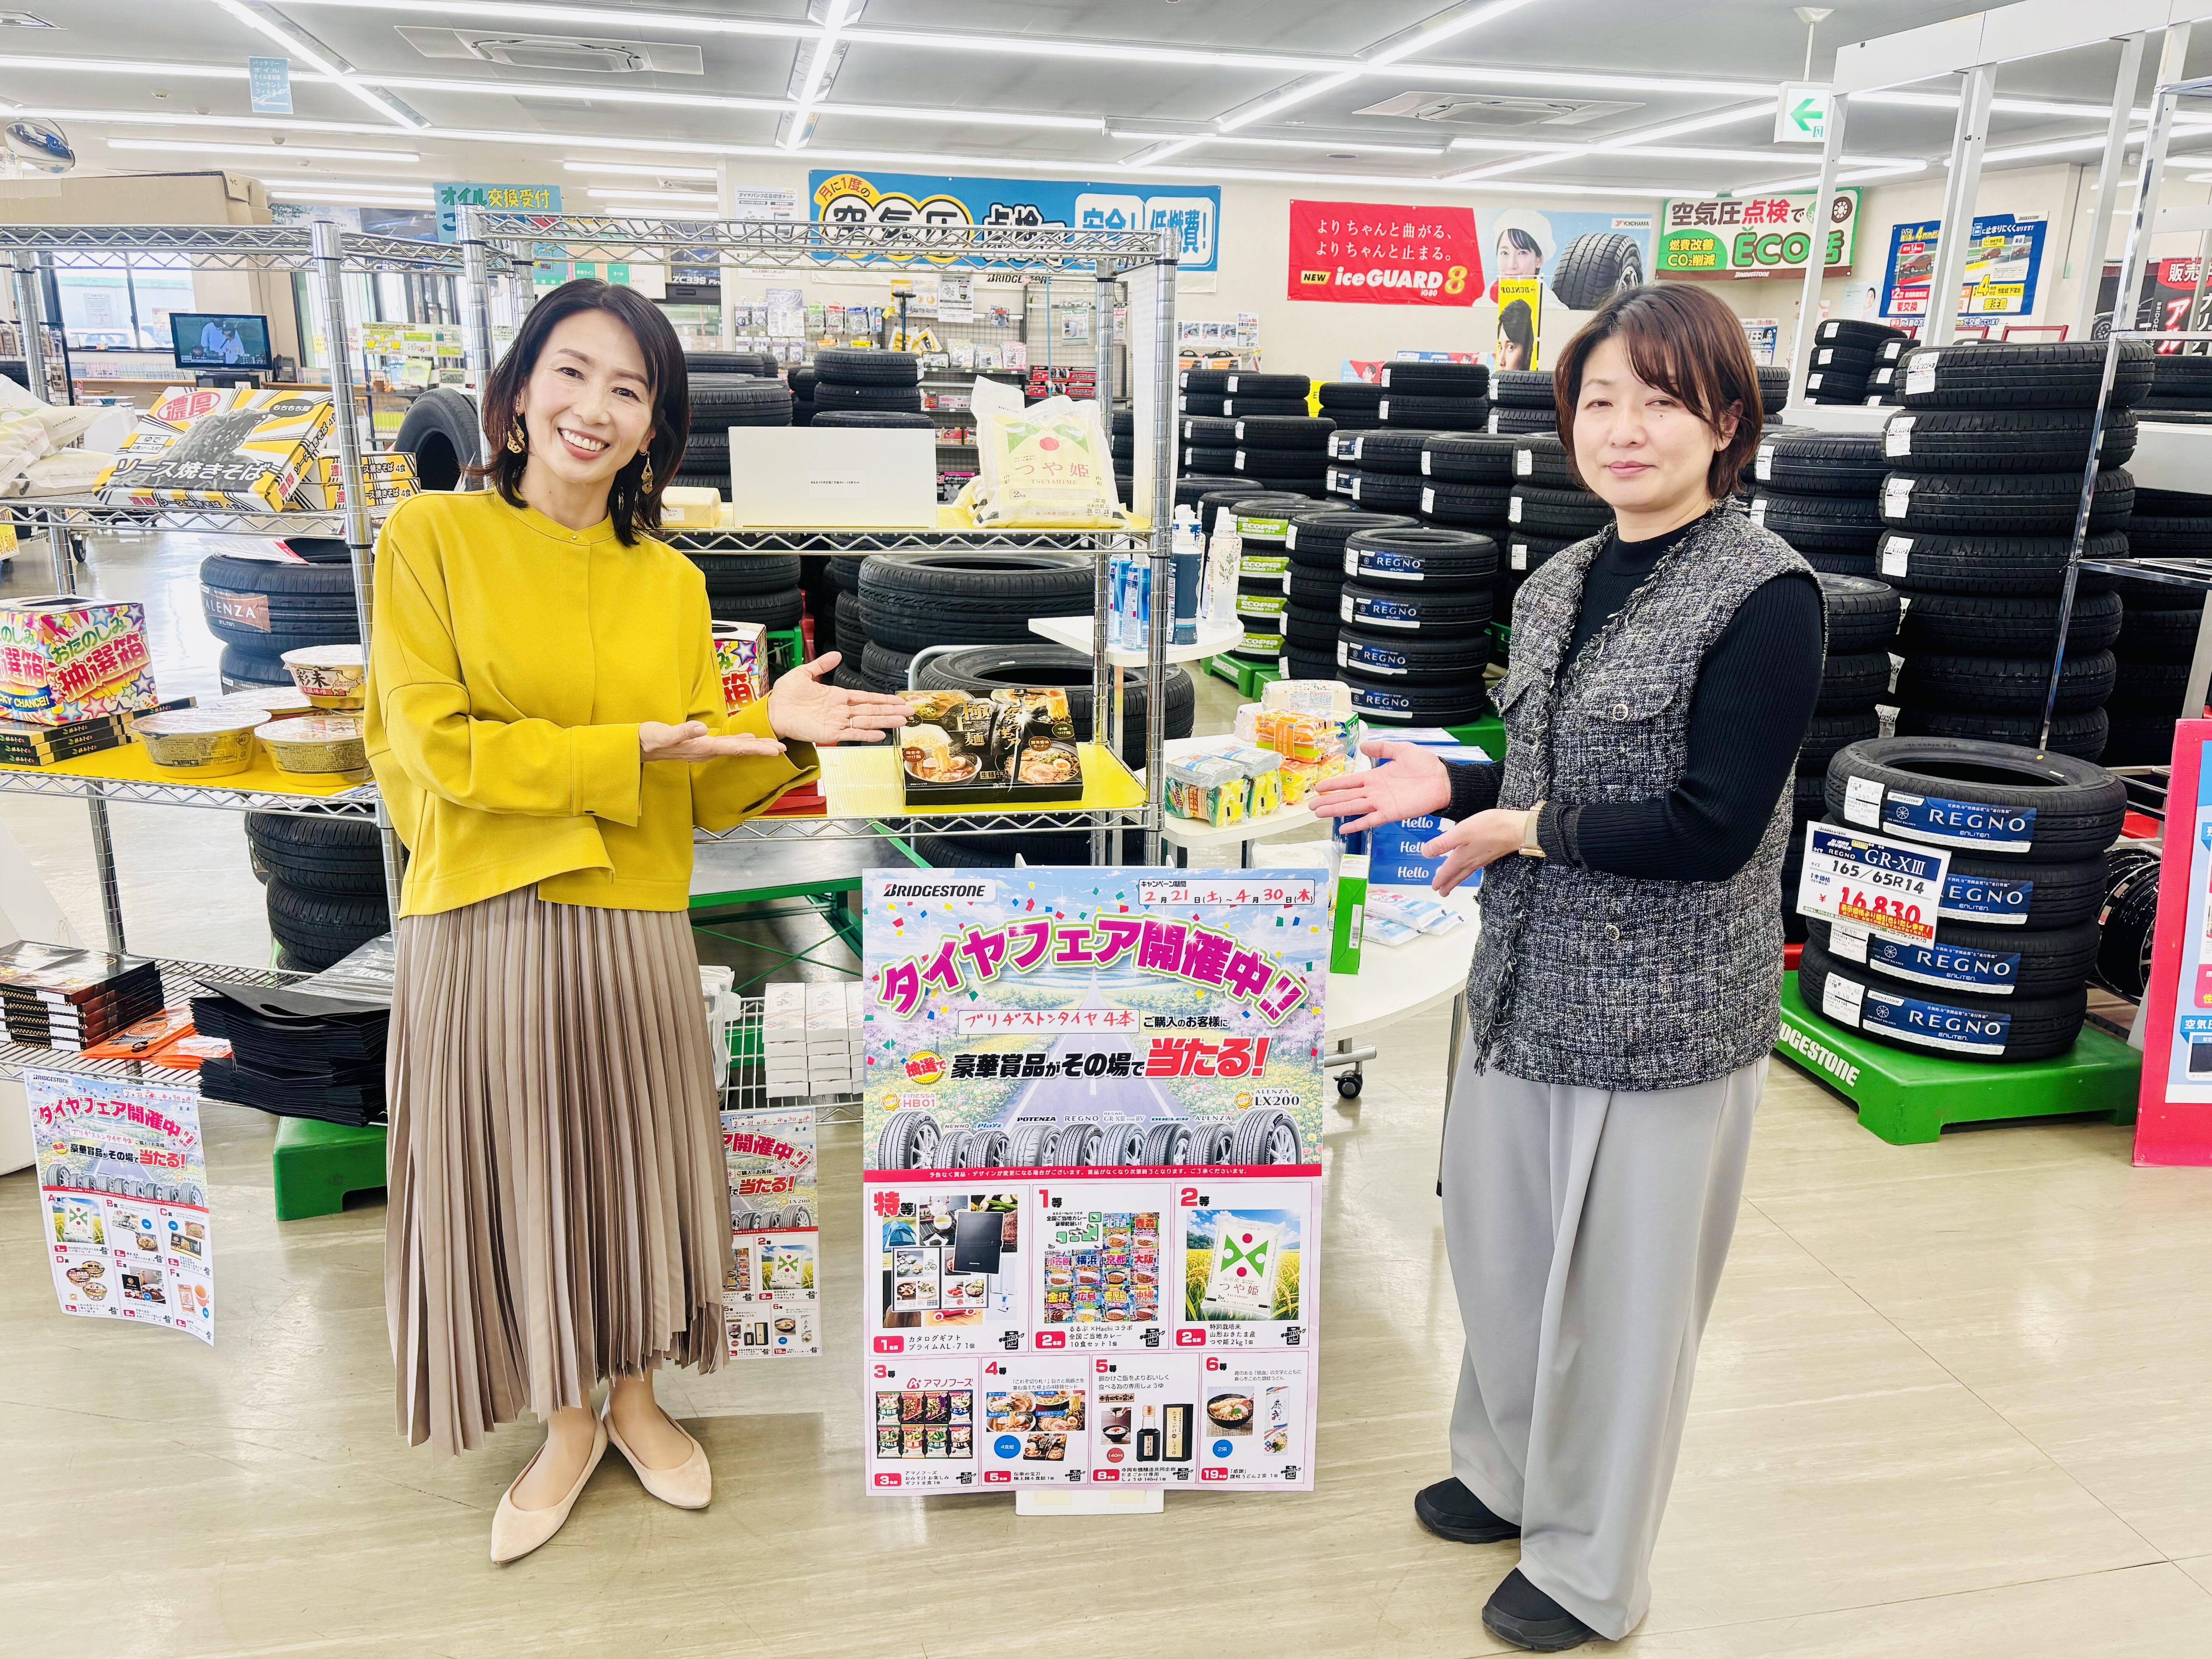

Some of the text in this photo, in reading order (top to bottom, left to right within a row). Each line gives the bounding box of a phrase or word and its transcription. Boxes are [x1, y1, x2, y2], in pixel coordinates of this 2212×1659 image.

[819, 177, 871, 202] 月に1度の
[1672, 198, 1805, 226] 空気圧点検で
[1668, 238, 1715, 252] 燃費改善
[672, 276, 707, 285] ZC33S
[1303, 272, 1327, 282] NEW
[1334, 265, 1444, 289] iceGUARD
[1983, 298, 2008, 310] 要注意
[166, 395, 213, 418] 濃厚
[112, 458, 274, 482] ソース焼きそば
[1015, 462, 1090, 478] つや姫
[157, 498, 223, 509] ソース焼きそば
[1242, 522, 1280, 531] ECOPIA
[1377, 556, 1420, 568] REGNO
[205, 598, 256, 619] ALENZA
[1373, 605, 1417, 617] REGNO
[51, 617, 127, 665] おたのしみ
[1364, 651, 1406, 665] REGNO
[56, 632, 147, 698] 抽選箱
[14, 694, 50, 708] CHANCE!!
[1366, 695, 1409, 708] REGNO
[948, 701, 991, 747] 極上麺
[1401, 816, 1434, 829] Hello
[1929, 808, 2026, 832] REGNO
[1828, 848, 1856, 860] REGNO
[1397, 866, 1429, 879] Hello
[883, 884, 986, 897] BRIDGESTONE
[1940, 886, 2023, 905] EGNO
[1917, 950, 2010, 976] REGNO
[1143, 1015, 1228, 1028] ご購入のお客様に
[1908, 1010, 2001, 1036] REGNO
[1779, 1022, 1861, 1087] DGESTONE
[905, 1056, 946, 1078] 抽選で
[33, 1074, 69, 1085] BRIDGESTONE
[903, 1099, 935, 1108] HB01
[1255, 1096, 1300, 1106] LX200
[1105, 1217, 1156, 1228] 北海道 青森
[1047, 1254, 1154, 1266] 小笠原 横浜 京都 大阪
[1047, 1290, 1154, 1303] 金沢 広島 鹿児島 沖縄
[1219, 1283, 1259, 1297] つや姫
[909, 1334, 961, 1343] カタログギフト
[924, 1378, 974, 1388] アマノフーズ
[1098, 1382, 1164, 1390] 食べる為の専用しょうゆ
